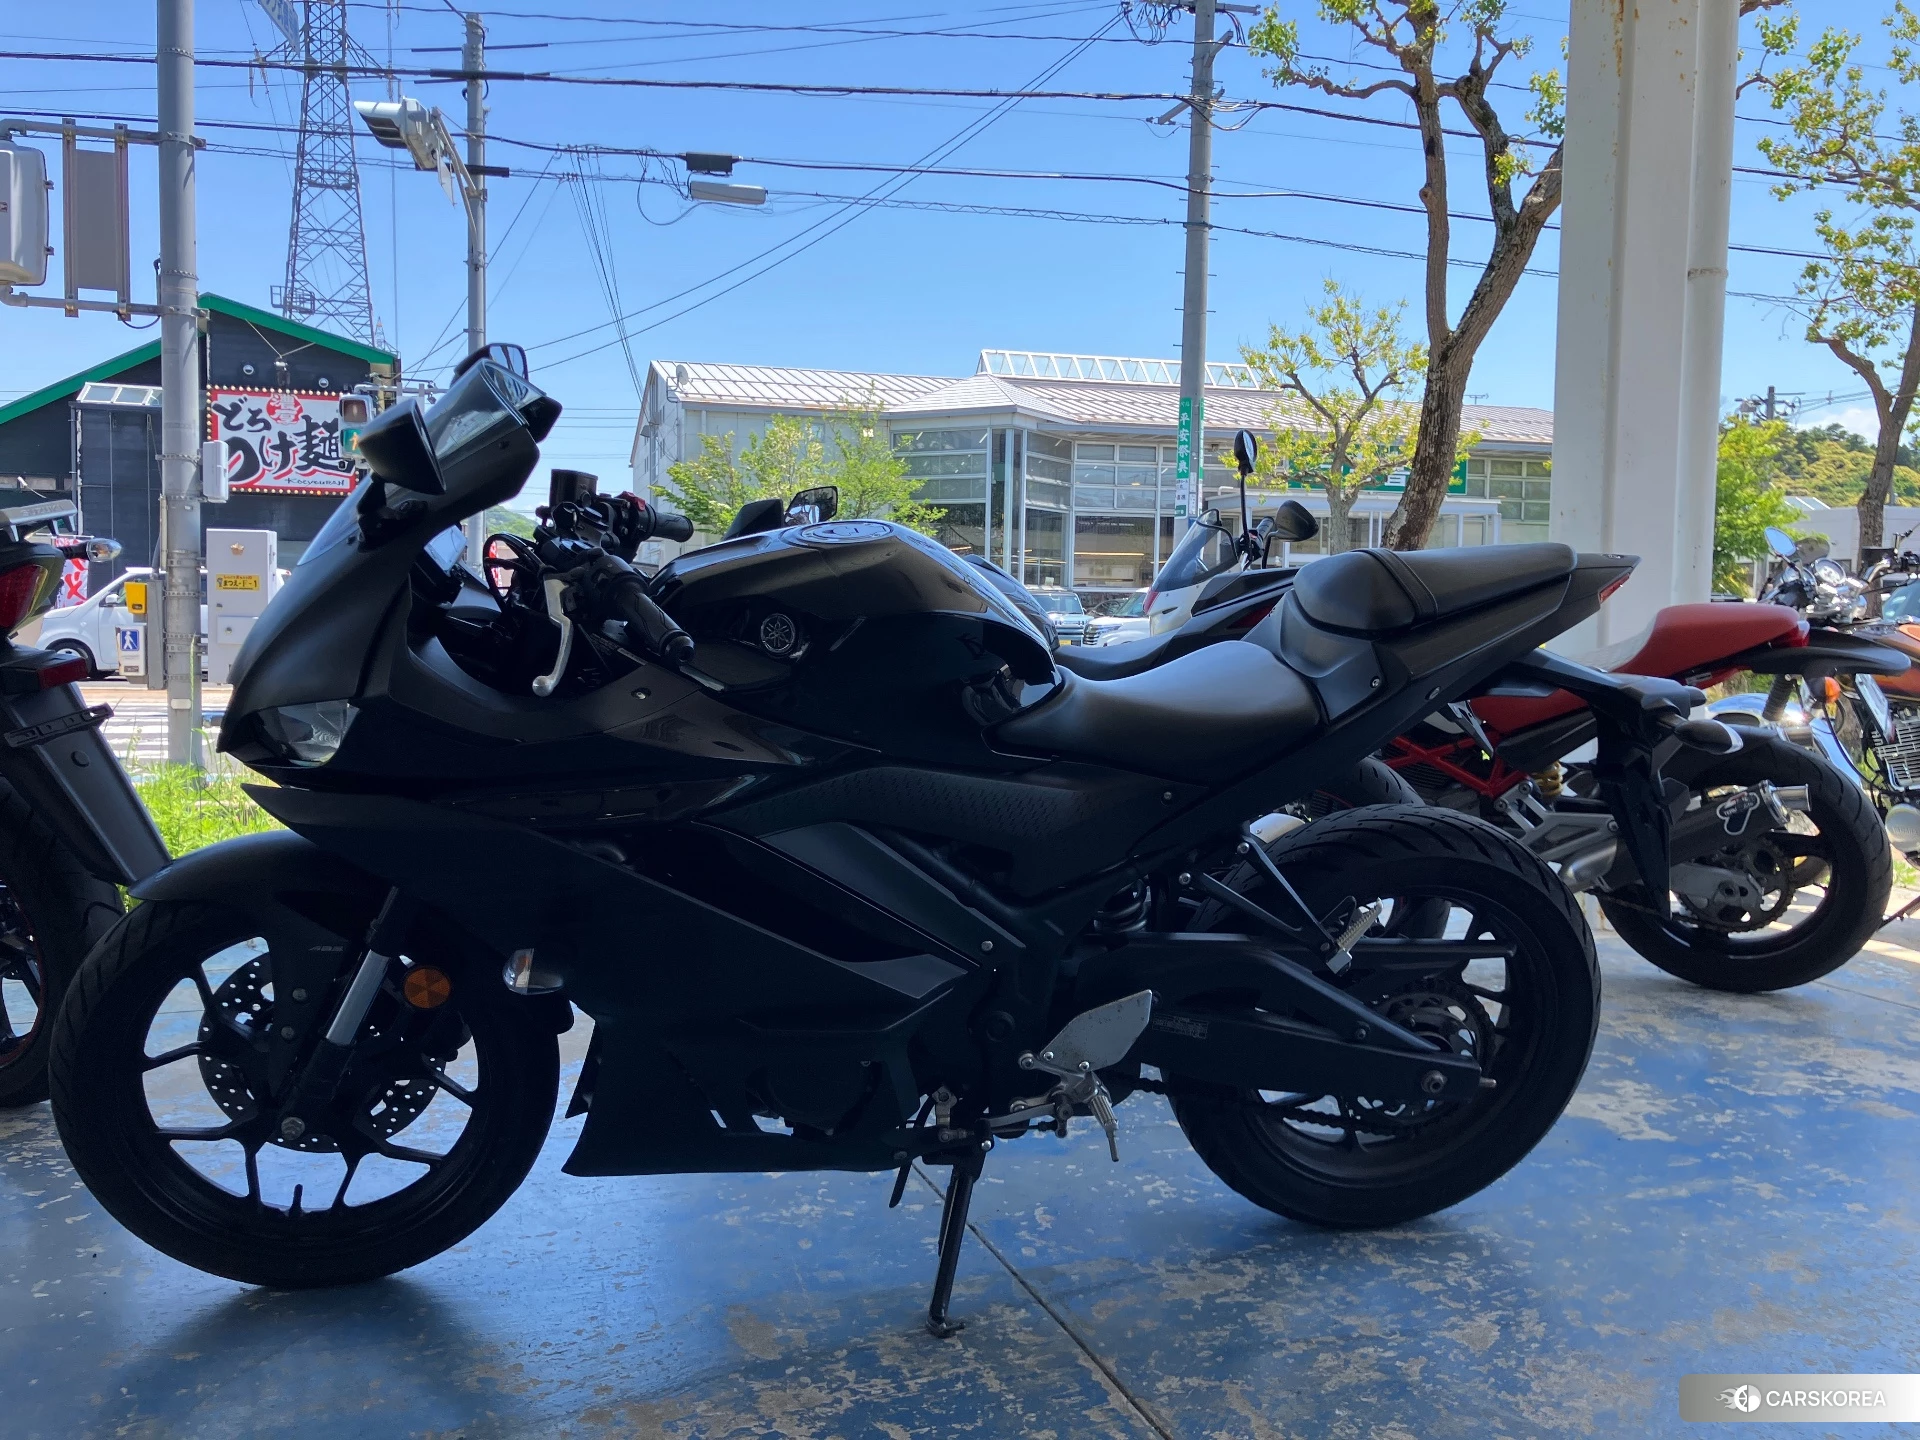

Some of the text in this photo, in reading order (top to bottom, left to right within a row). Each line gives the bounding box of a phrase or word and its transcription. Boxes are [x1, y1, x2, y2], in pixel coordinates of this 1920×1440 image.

[212, 396, 272, 432] どろ
[1178, 412, 1190, 473] 平安祭典
